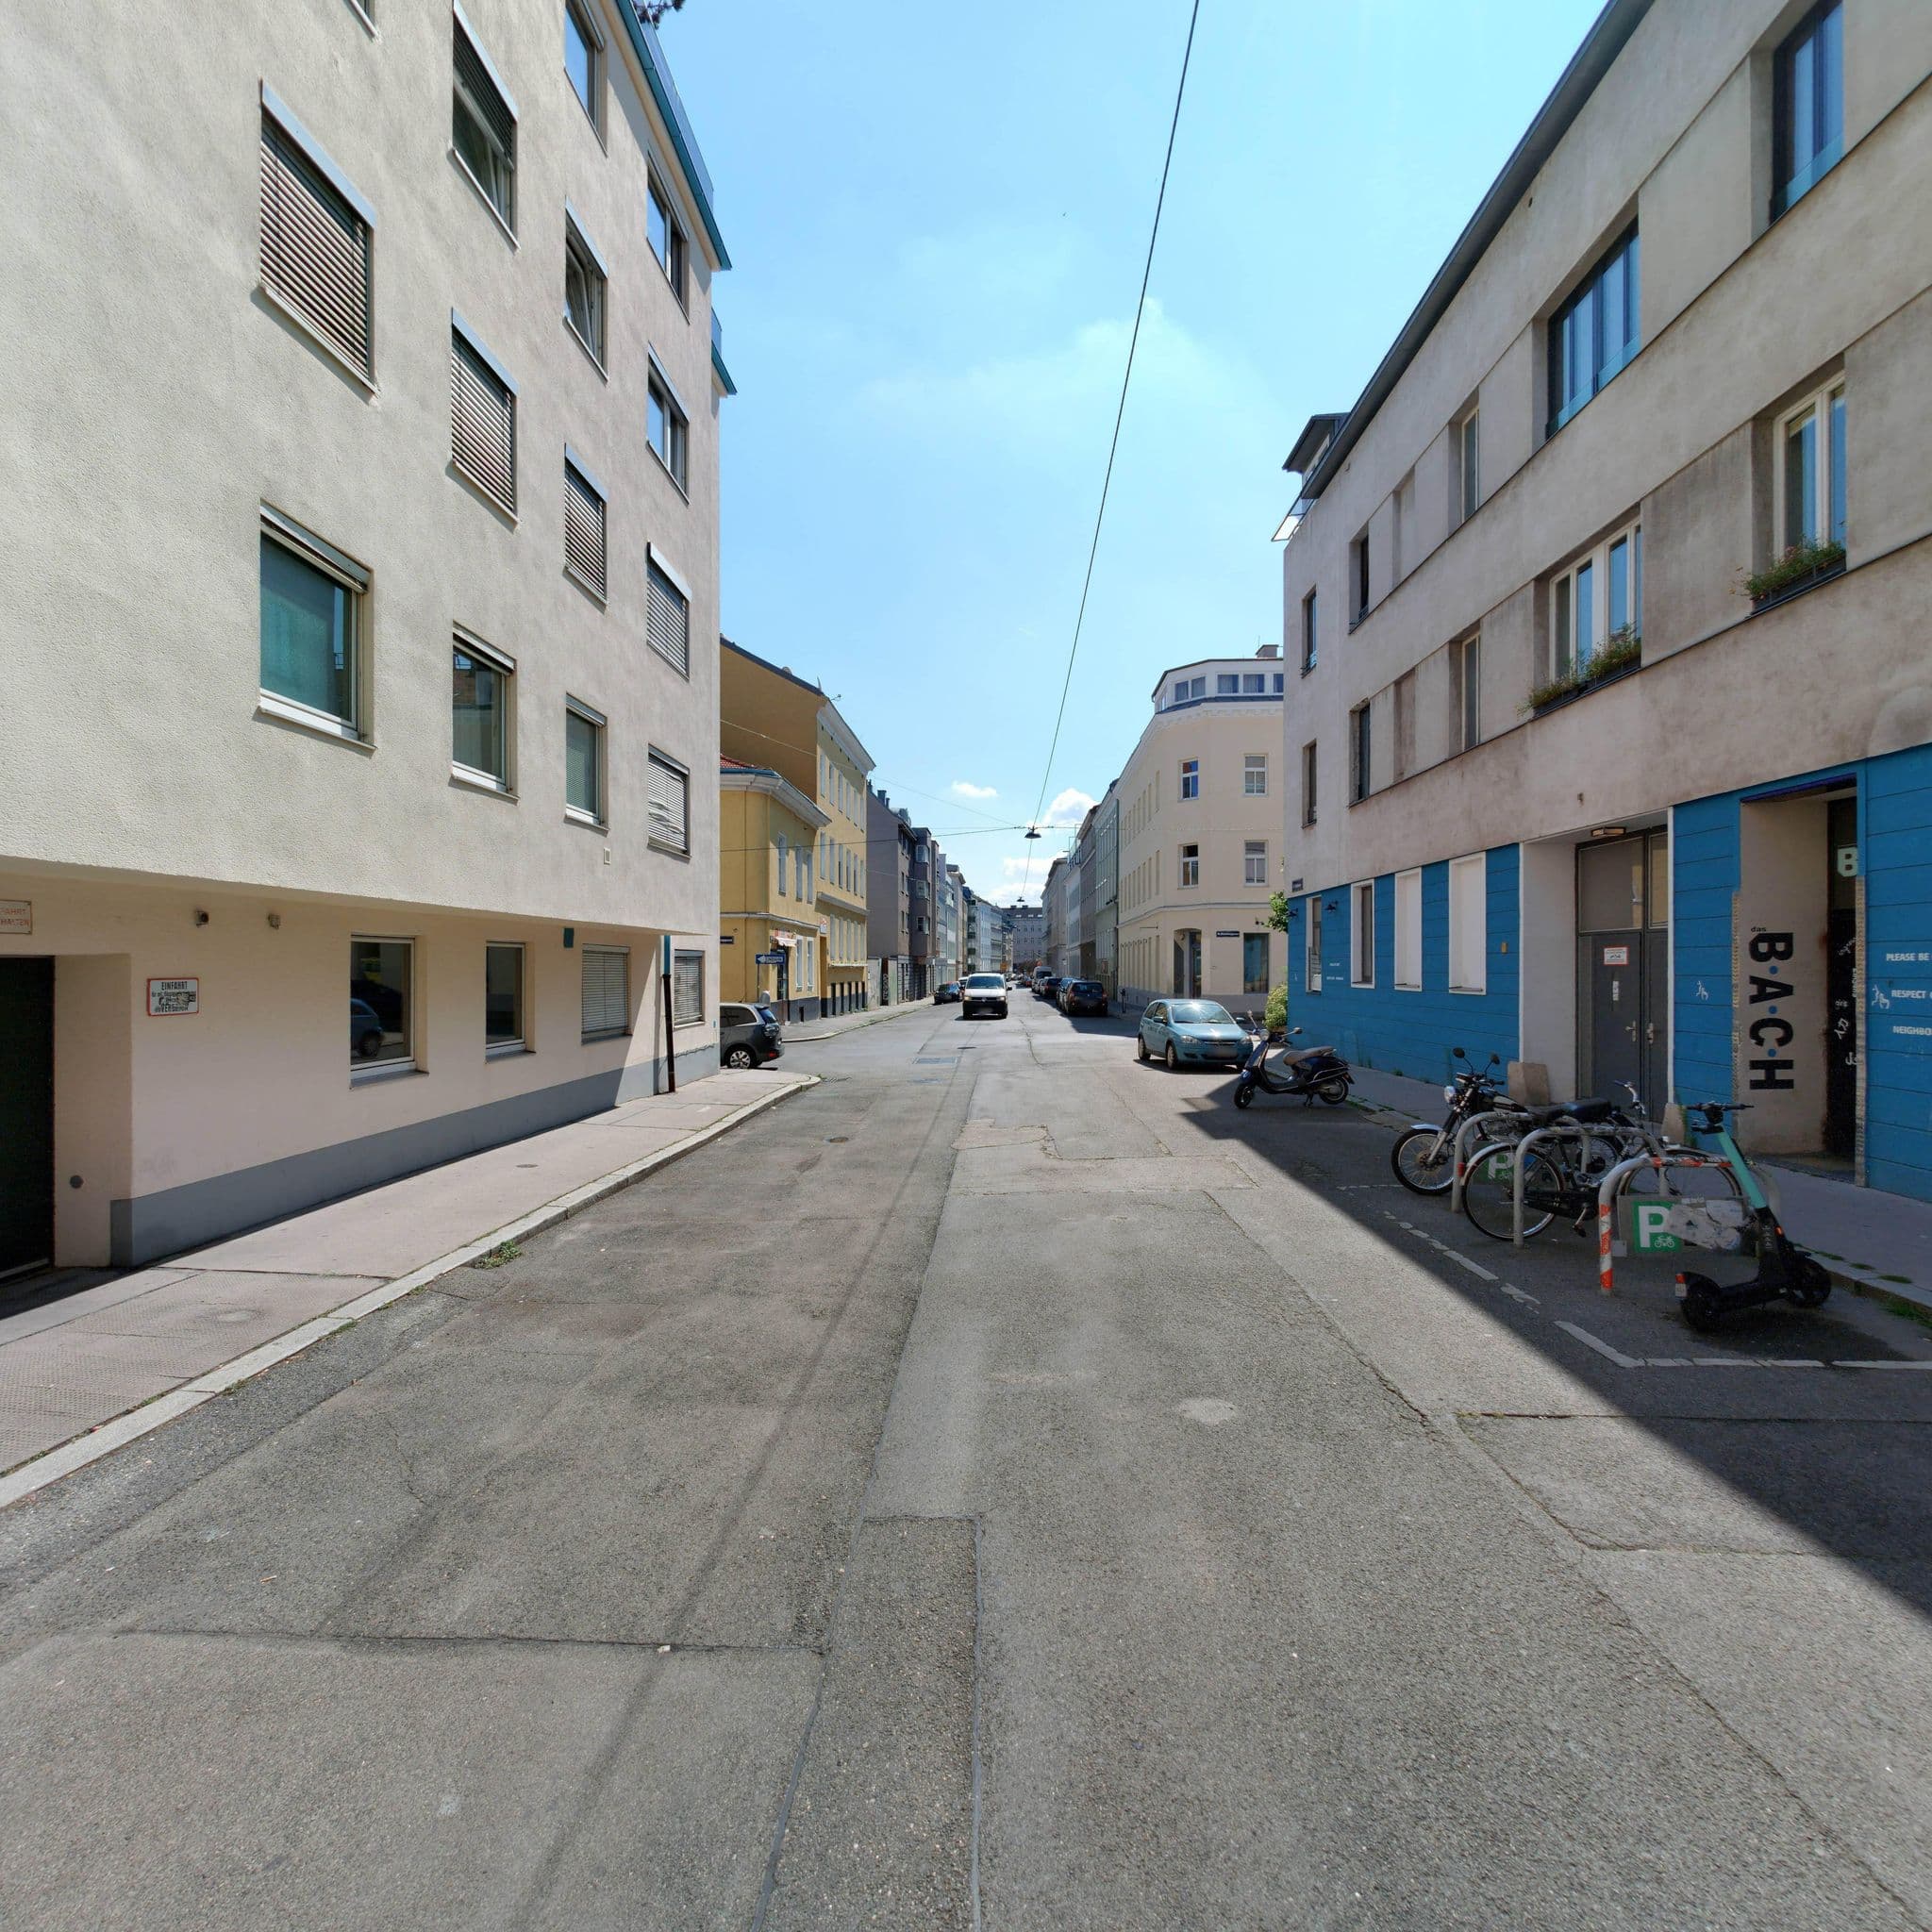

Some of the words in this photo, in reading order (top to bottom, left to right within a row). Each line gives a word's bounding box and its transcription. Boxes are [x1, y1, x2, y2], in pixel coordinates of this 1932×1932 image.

[1886, 952, 1917, 962] PLEASE
[1918, 952, 1930, 961] BE
[160, 980, 189, 991] EINFAHRT
[1890, 990, 1926, 999] RESPECT
[1638, 1205, 1672, 1249] P
